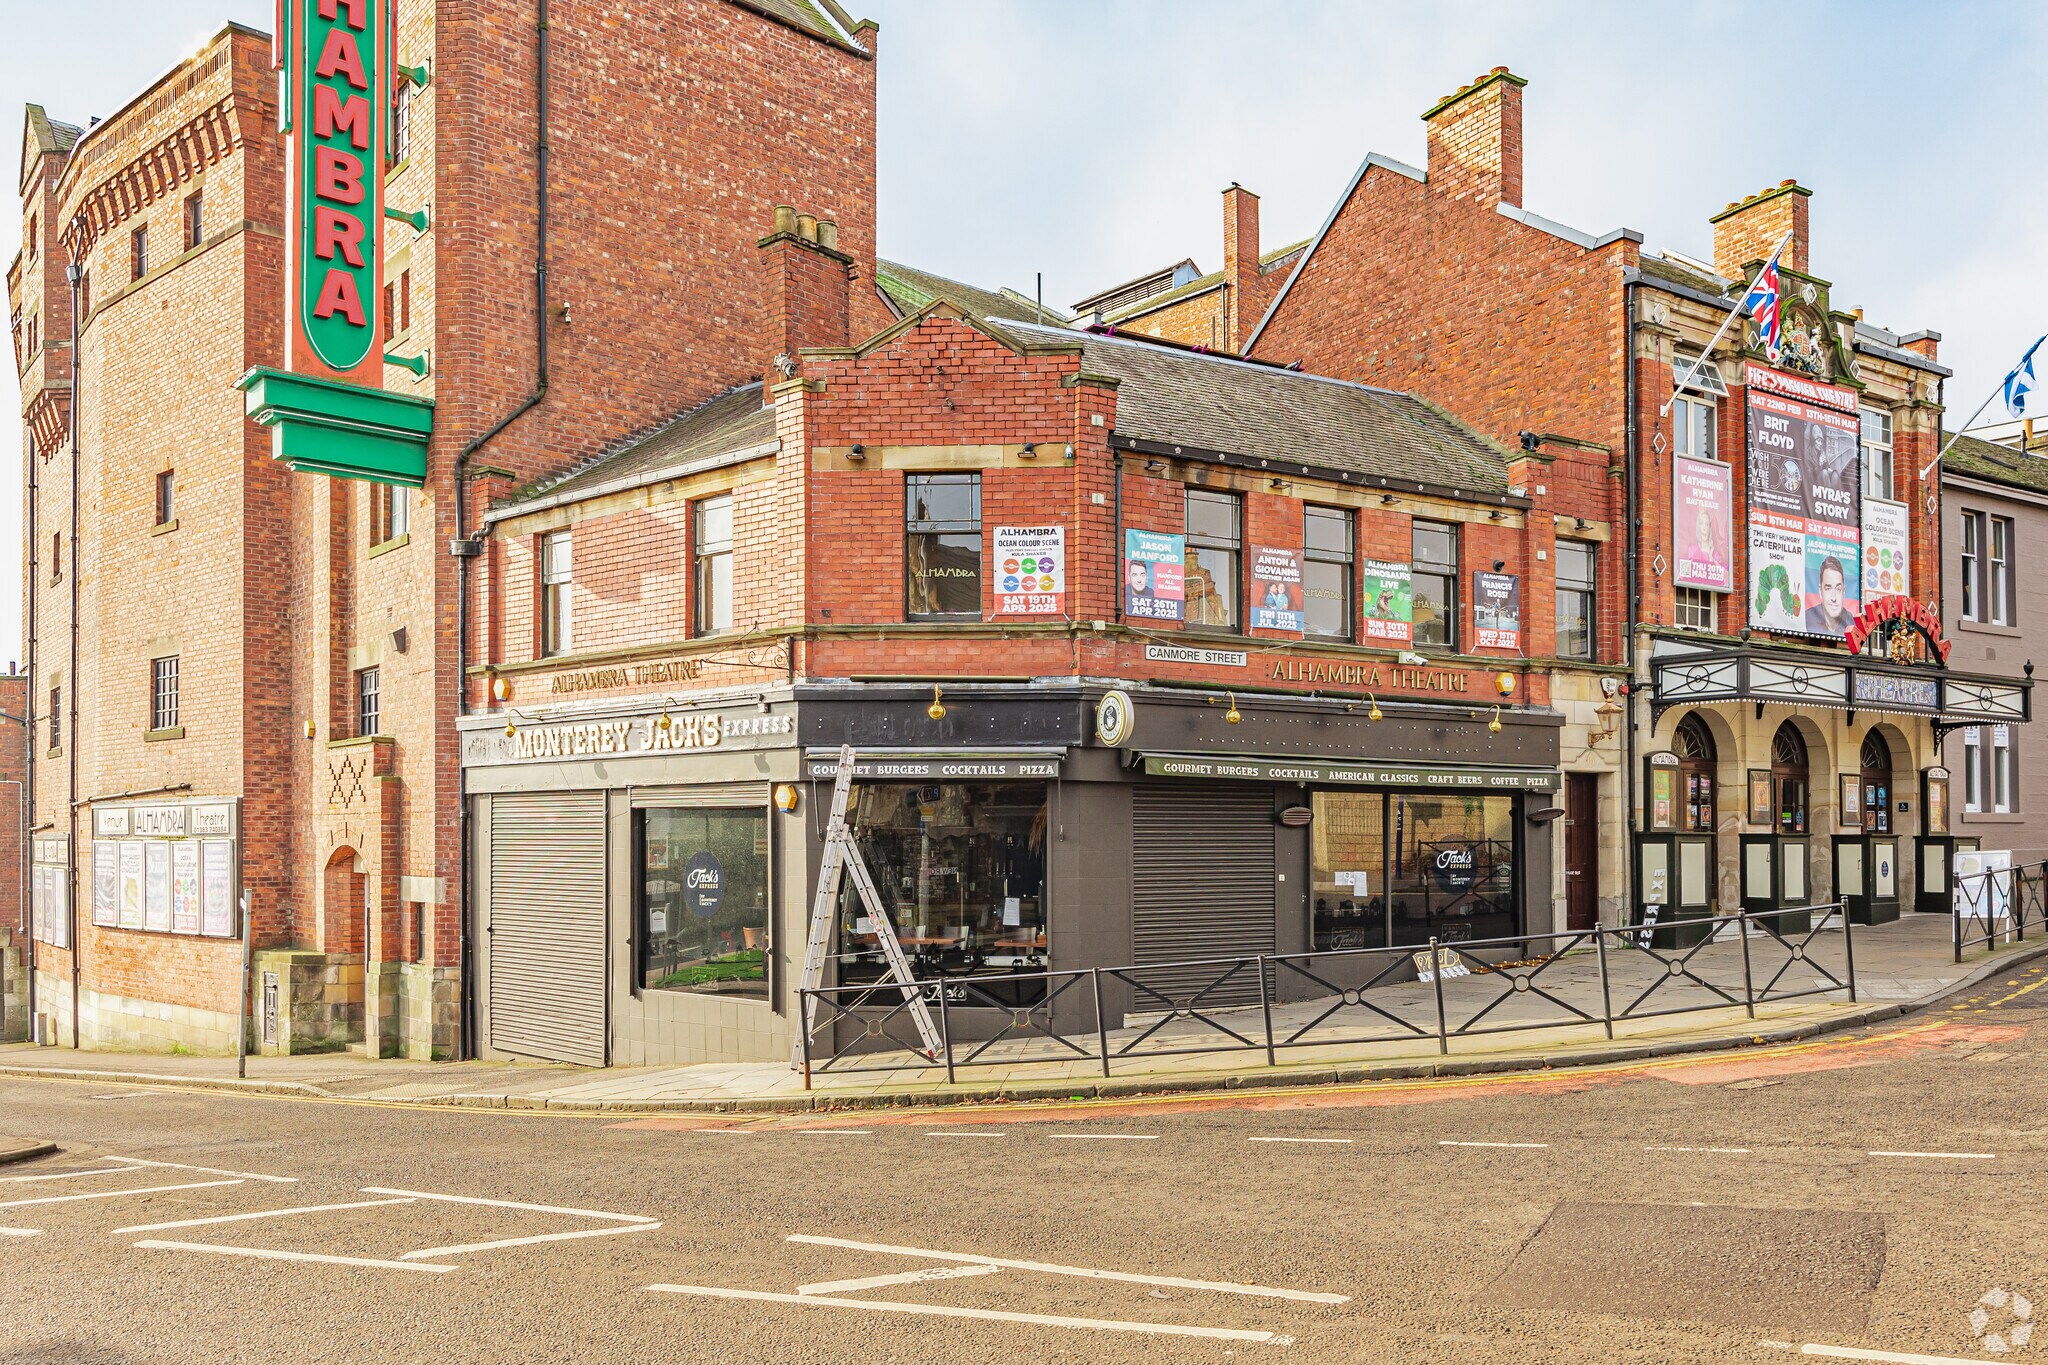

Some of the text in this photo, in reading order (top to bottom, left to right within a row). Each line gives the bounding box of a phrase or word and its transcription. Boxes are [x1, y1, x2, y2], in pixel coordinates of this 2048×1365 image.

[1747, 366, 1777, 389] FIFE'S
[1816, 385, 1855, 409] THEATRE
[1751, 395, 1802, 415] SAT 22ND FEB
[1764, 415, 1789, 432] BRIT
[1805, 409, 1857, 430] 13TH-15TH MAR
[1758, 430, 1794, 450] FLOYD
[1751, 449, 1769, 462] WISH
[1687, 464, 1718, 477] ALHAMBRA
[1751, 459, 1769, 469] YOU
[1751, 468, 1769, 480] WERE
[1681, 474, 1724, 491] KATHERINE
[1751, 477, 1769, 489] HERE
[1692, 487, 1714, 500] RYAN
[1812, 484, 1851, 505] MYRA'S
[1686, 497, 1719, 510] BATTLEAXE
[1814, 501, 1850, 520] STORY
[1750, 511, 1803, 530] SUN 16TH MAR
[1875, 517, 1895, 526] OCEAN
[1000, 528, 1057, 536] ALHAMBRA
[1138, 532, 1173, 542] ALHAMBRA
[1753, 529, 1801, 544] THE VERY HUNGRY
[1808, 523, 1857, 540] SAT 26TH APR
[1865, 523, 1888, 534] COLOUR
[1888, 528, 1905, 538] SCENE
[1018, 539, 1041, 547] COLOUR
[1140, 541, 1171, 552] JASON
[1753, 539, 1802, 555] CATERPILLAR
[1131, 550, 1179, 563] MANFORD
[1261, 547, 1293, 556] ALHAMBRA
[1769, 552, 1785, 561] SHOW
[1258, 555, 1297, 567] ANTON &
[1367, 560, 1409, 572] ALHAMBRA
[1692, 562, 1725, 573] THU 20TH
[915, 567, 977, 577] ALHAMBRA
[1255, 565, 1300, 577] GIOVANNI:
[1364, 568, 1411, 581] DINOSAURS
[1482, 573, 1510, 581] ALHAMBRA
[1692, 569, 1724, 581] MAR 2025
[1254, 573, 1300, 583] TOGETHER AGAIN
[1380, 580, 1399, 589] LIVE
[1157, 584, 1182, 592] SEASONS
[1482, 580, 1513, 591] FRANCIS
[1003, 595, 1056, 604] SAT 19TH
[1487, 589, 1508, 599] ROSSI
[1002, 604, 1057, 612] APR 2025
[1132, 597, 1178, 609] SAT 26TH
[1412, 600, 1450, 611] LHAMBRA
[1132, 606, 1178, 618] APR 2025
[1259, 610, 1296, 621] FRI 11TH
[1258, 617, 1298, 629] JUL 2025
[1367, 619, 1408, 632] SUN 30TH
[1844, 594, 1952, 665] ALHAMBRA
[1367, 627, 1408, 639] MAR 2025
[1479, 630, 1517, 641] WED 15TH
[1479, 637, 1515, 648] OCT 2025
[1149, 647, 1243, 664] CANMORE STREET
[551, 659, 702, 694] ALHAMBRA THEATRE
[1272, 660, 1468, 692] ALHAMBRA THEATRE
[514, 721, 632, 759] MONTEREY
[639, 714, 722, 750] JACK'S
[723, 715, 792, 736] EXPRESS
[813, 764, 1054, 775] GOUET BURGERS COCKTAILS PIZZA
[1164, 763, 1549, 786] GOURMET BURGERS COCKTAILS AMERICAN CLASSICS CRAFT BEERS COFFEE PIZZA
[104, 812, 124, 828] Venue
[136, 810, 185, 833] ALHAMBRA
[195, 807, 225, 826] Theatre
[1436, 850, 1472, 869] Jack's
[687, 869, 719, 888] Jack's
[1330, 933, 1362, 951] Jack's
[1417, 964, 1471, 983] EXRESS
[923, 984, 966, 1002] Jck's
